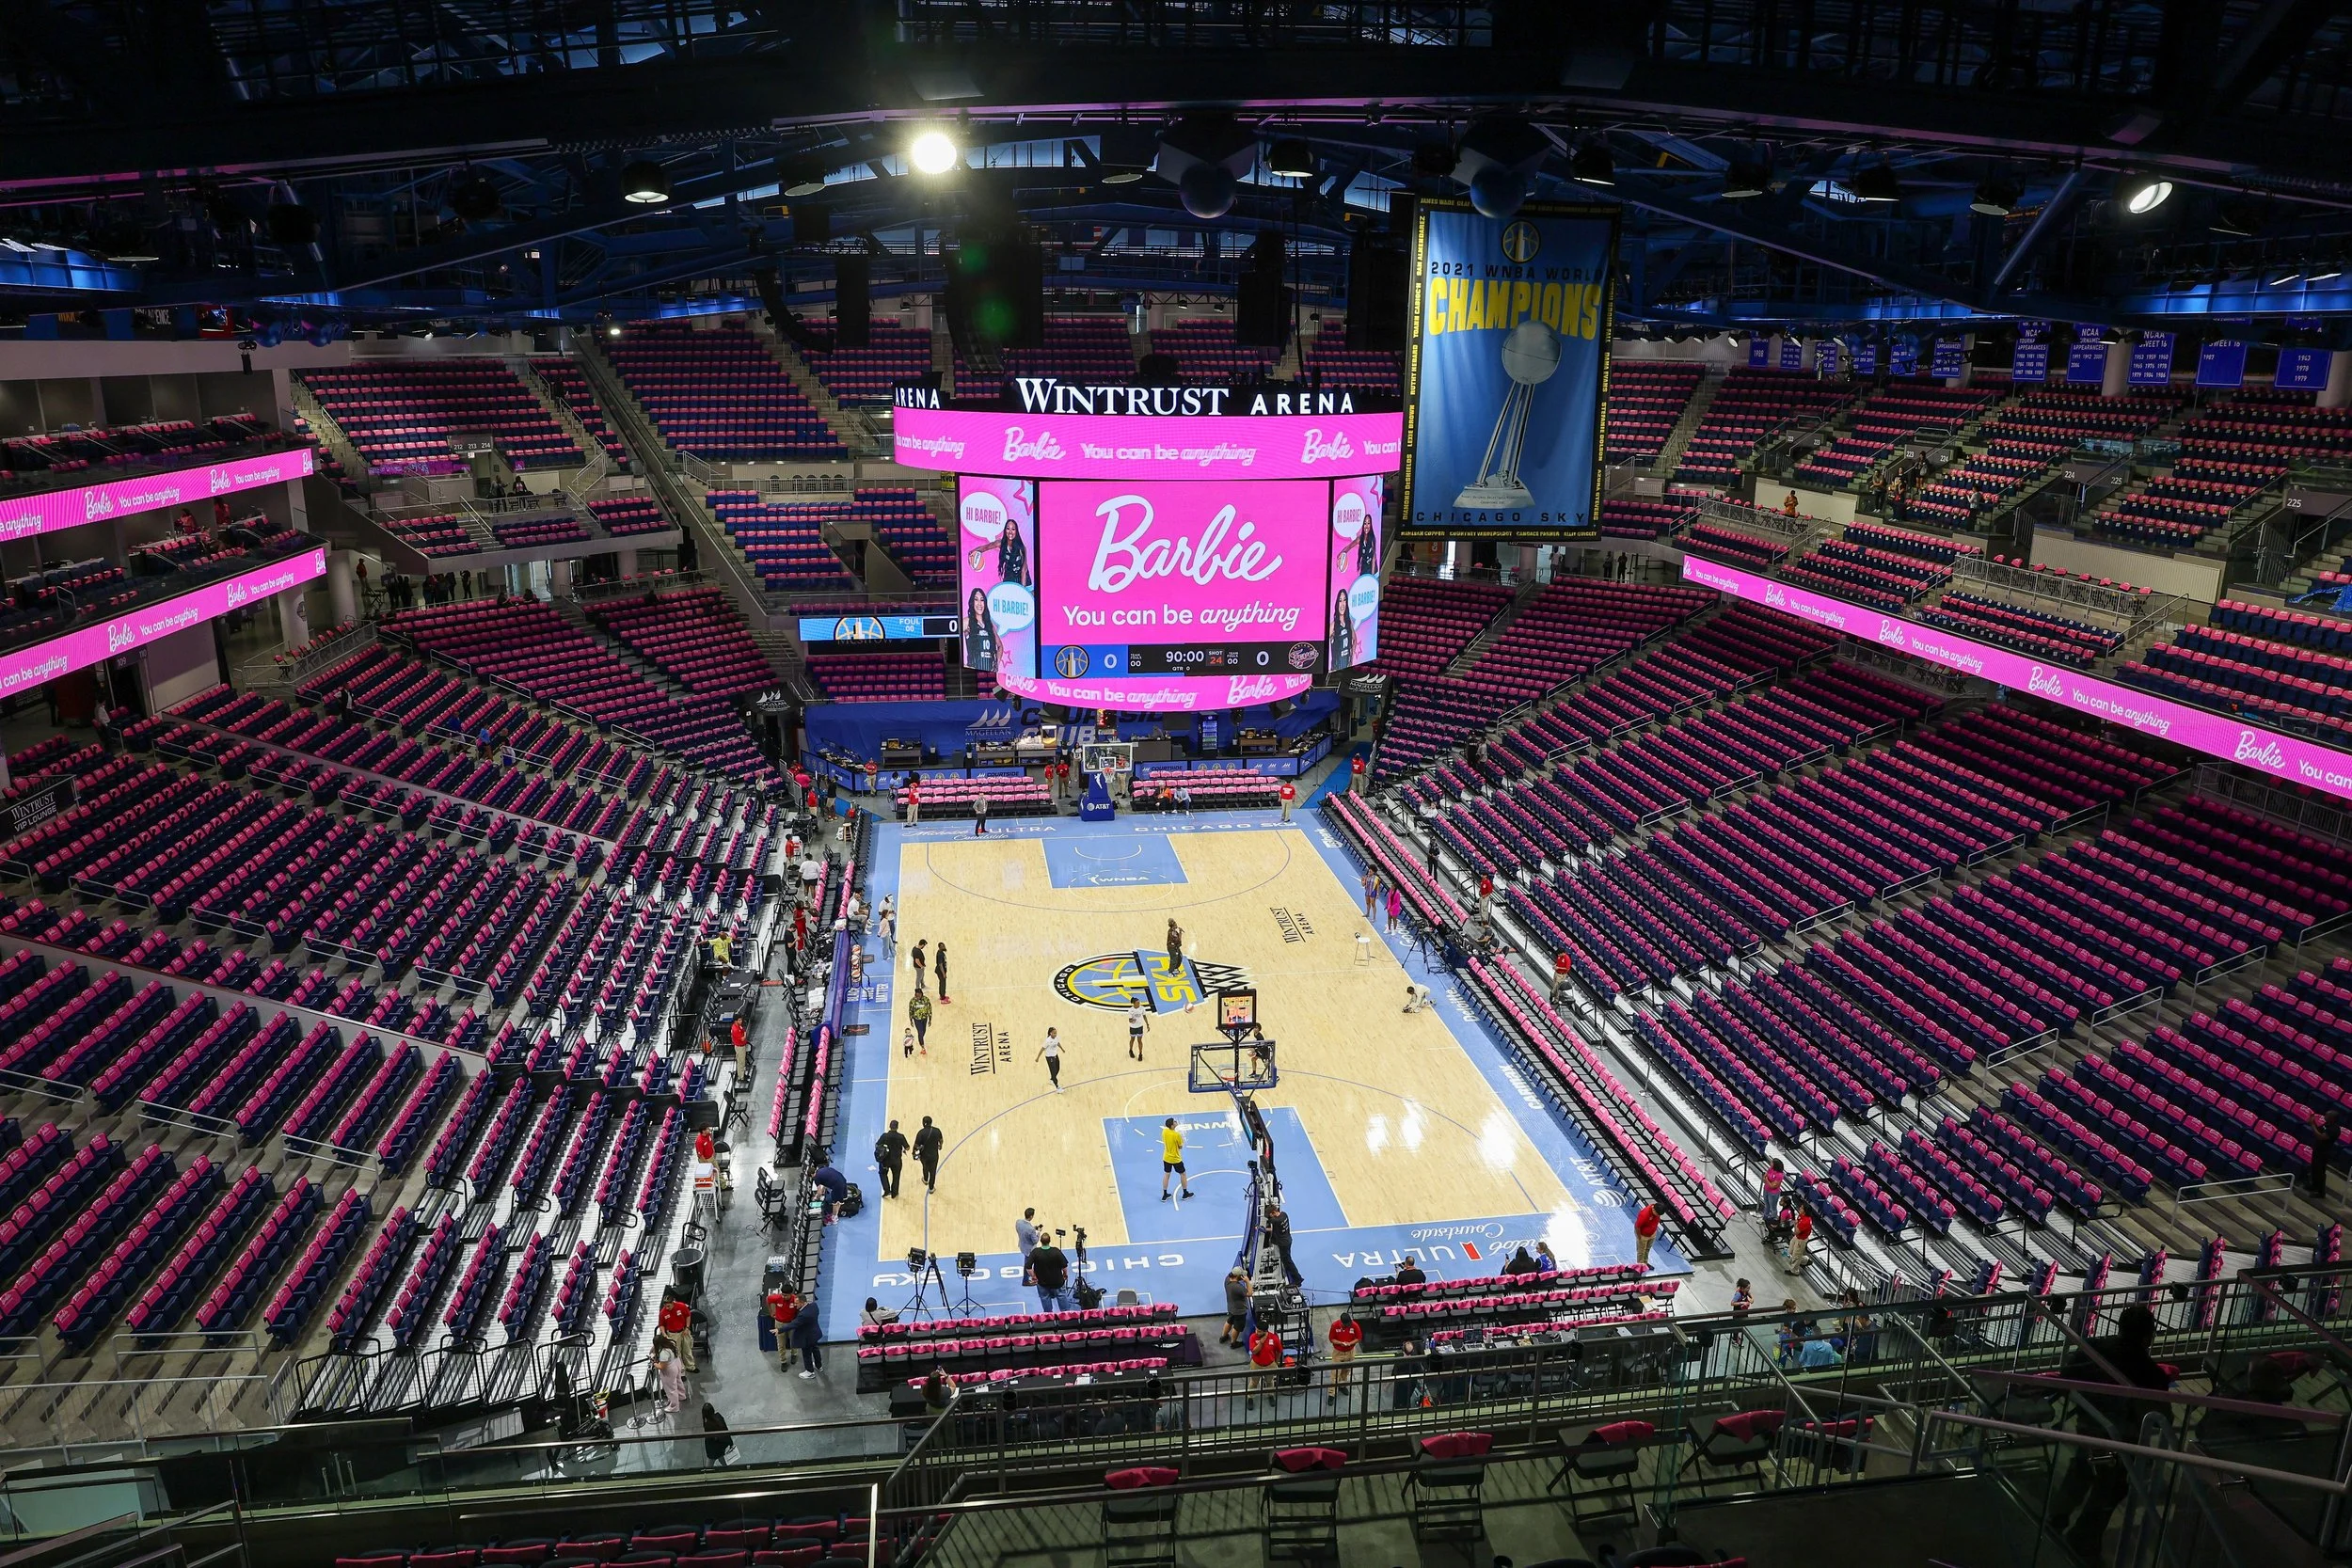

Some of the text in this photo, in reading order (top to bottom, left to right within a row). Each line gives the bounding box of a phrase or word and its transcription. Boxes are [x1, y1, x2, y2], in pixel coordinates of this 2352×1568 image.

[1431, 261, 1603, 281] 2021 WNBA WORLD
[1428, 277, 1603, 341] CHAMPIONS
[2081, 328, 2099, 337] NCAA
[895, 387, 941, 409] ARENA
[1016, 378, 1354, 415] WINTRUST ARENA
[912, 436, 922, 450] be
[923, 436, 966, 459] anything
[1003, 427, 1066, 462] Barbie
[1080, 443, 1258, 467] You can be anything
[1301, 429, 1354, 464] Barbie
[1363, 440, 1397, 455] You can
[210, 468, 231, 493] Barbie
[2064, 470, 2122, 485] 224 225
[85, 485, 181, 519] Barbie You can be anything
[2287, 498, 2302, 509] 225
[6, 513, 41, 535] anything
[966, 507, 1001, 525] HI BARBIE!
[1343, 509, 1361, 522] BARBIE!
[1416, 512, 1585, 523] CHICAGO SKY
[1088, 494, 1282, 594] Barbie
[226, 584, 246, 608] Barbie
[993, 598, 1028, 616] HI BARBIE!
[1765, 584, 1846, 628] Barbie You can be anything
[948, 621, 957, 632] 0
[1062, 601, 1300, 633] You can be anything
[107, 608, 199, 652] Barbie You can be anything
[982, 640, 990, 650] 10
[1166, 651, 1204, 662] 90:00
[1879, 620, 1983, 673] Barbie You can be anything
[33, 655, 68, 679] anything
[1104, 654, 1117, 669] 0
[1256, 651, 1269, 666] 0
[4, 668, 33, 689] can be
[1046, 681, 1071, 696] You
[1073, 688, 1101, 701] can
[1104, 687, 1126, 703] be
[1127, 688, 1198, 708] anything
[1227, 675, 1277, 705] Barbie
[1284, 676, 1299, 689] You
[2028, 666, 2170, 735] Barbie You can be anything
[2234, 730, 2352, 787] Barbie You can
[10, 791, 55, 821] WINTRUST
[14, 805, 57, 832] VIP LOUNGE
[990, 826, 1057, 834] ULTRA
[1135, 822, 1251, 832] CHICAGO
[1270, 907, 1303, 943] WINTRUST
[1295, 912, 1315, 935] ARENA
[1055, 965, 1081, 1004] CHICAGO
[1147, 956, 1198, 1004] SKY
[970, 1022, 990, 1076] WINTRUST
[999, 1031, 1011, 1063] ARENA
[1569, 1157, 1612, 1188] AT&T
[1411, 1222, 1504, 1239] Courtside
[1332, 1245, 1455, 1269] ULTRA
[873, 1271, 946, 1288] SKY
